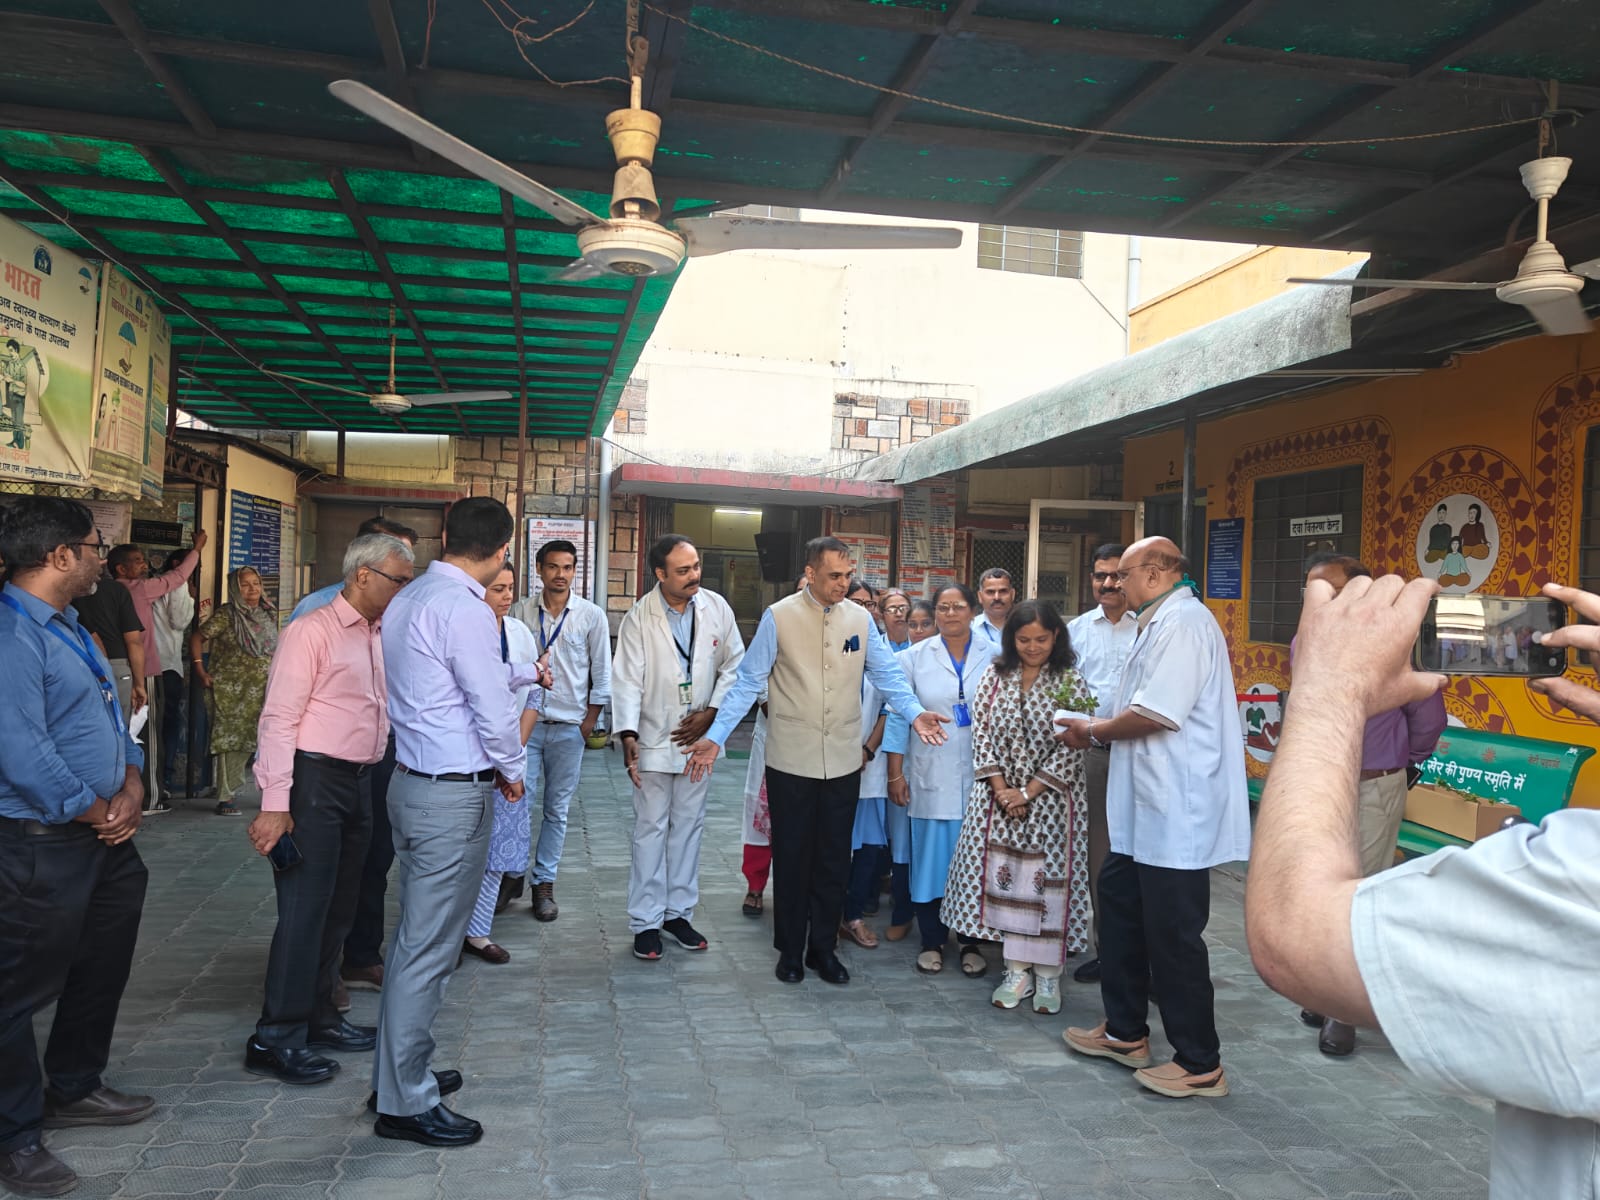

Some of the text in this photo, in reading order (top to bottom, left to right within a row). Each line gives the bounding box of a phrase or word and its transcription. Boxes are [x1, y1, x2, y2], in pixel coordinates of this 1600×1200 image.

[5, 262, 42, 300] भारत
[26, 320, 33, 334] के
[34, 327, 47, 340] पास
[1292, 523, 1303, 535] दवा
[1304, 519, 1325, 534] वितरण
[1427, 757, 1444, 774] खेर
[1445, 761, 1456, 778] की
[1457, 766, 1483, 784] पुण्य
[1484, 768, 1512, 792] स्मृति
[1513, 773, 1527, 792] में
